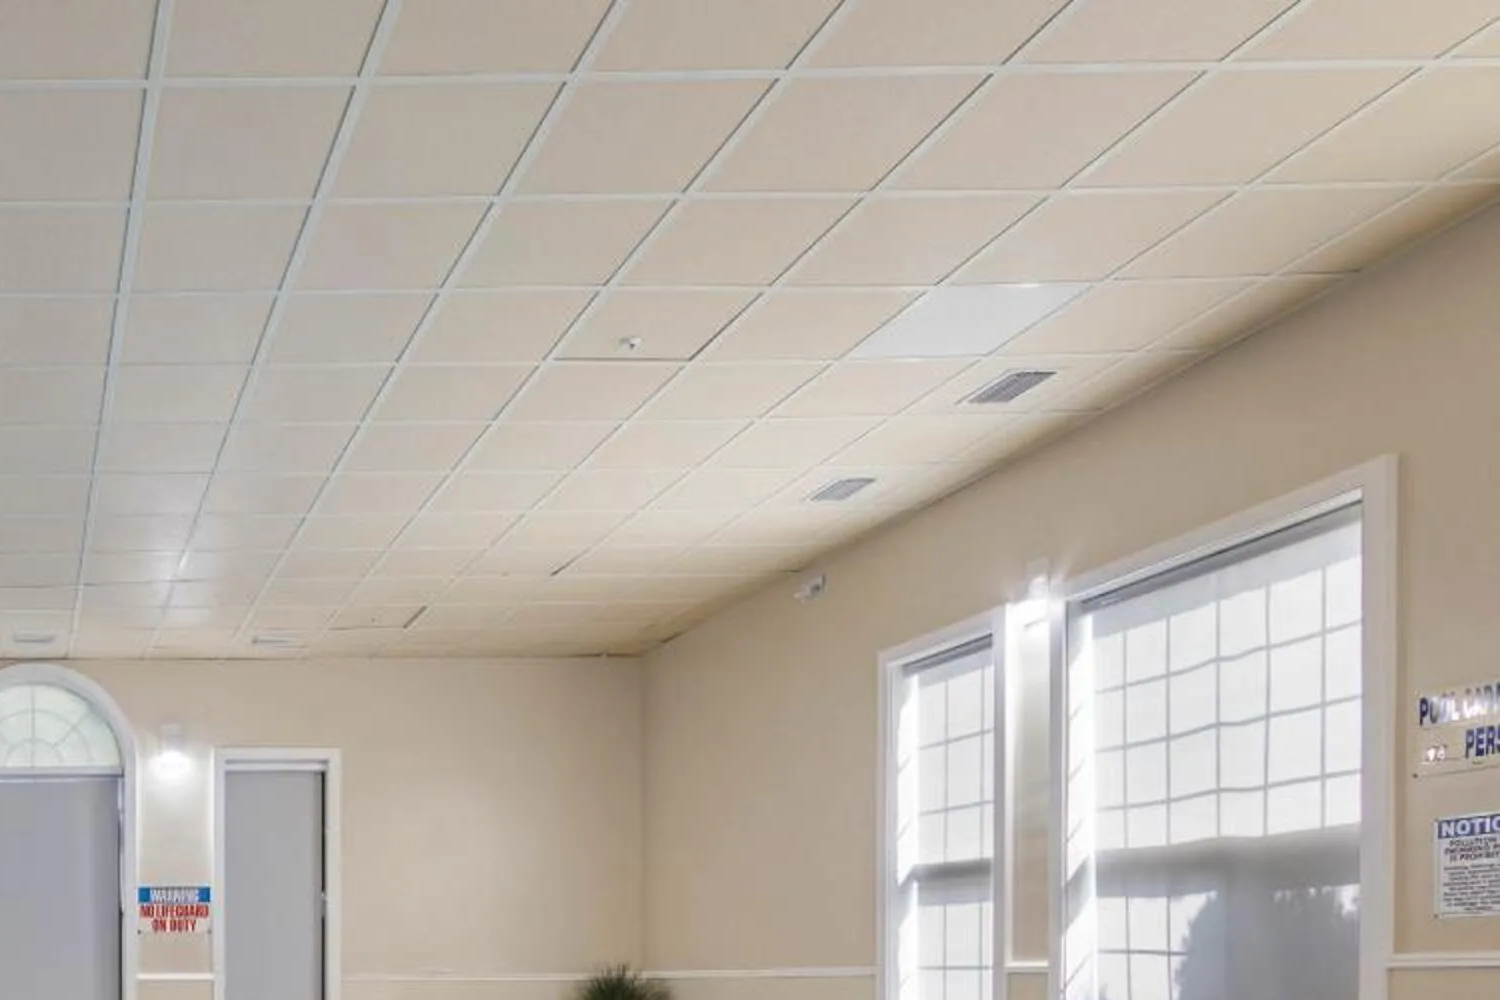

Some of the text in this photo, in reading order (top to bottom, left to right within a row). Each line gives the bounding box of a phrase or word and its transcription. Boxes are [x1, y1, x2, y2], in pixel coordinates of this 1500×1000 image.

[1419, 692, 1460, 726] POOL
[140, 904, 209, 918] NO LIFEGUARD
[151, 919, 197, 932] ON DUTY
